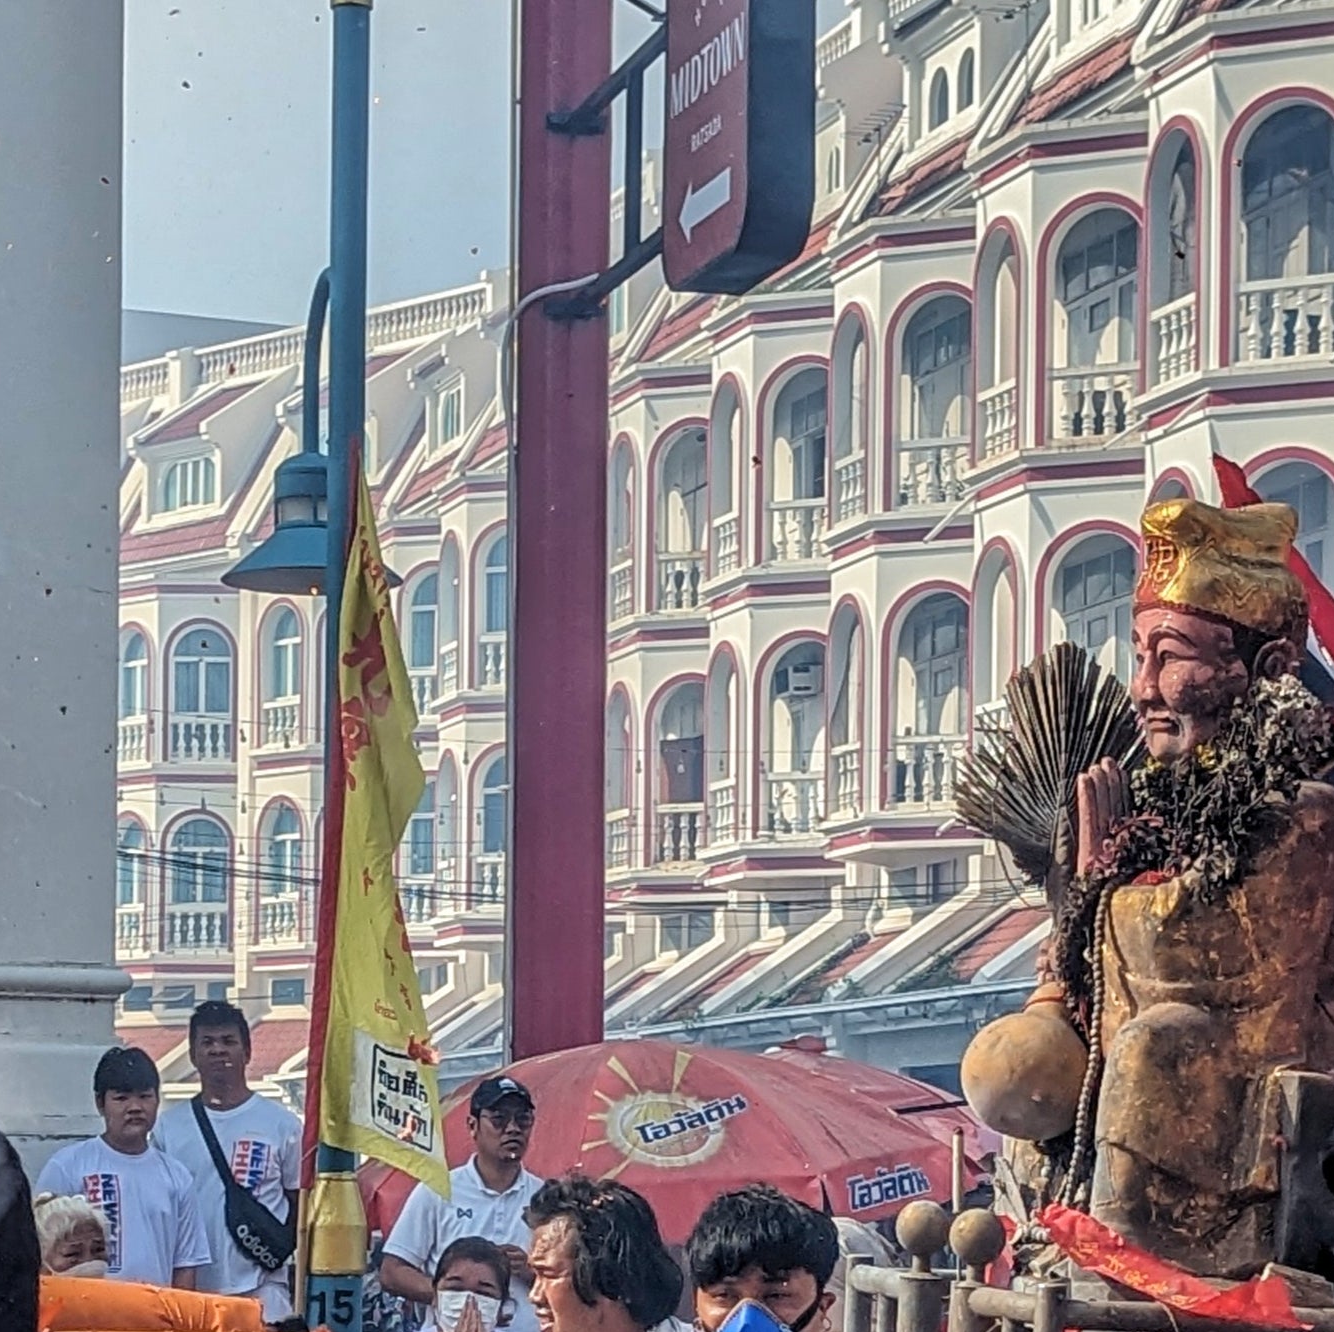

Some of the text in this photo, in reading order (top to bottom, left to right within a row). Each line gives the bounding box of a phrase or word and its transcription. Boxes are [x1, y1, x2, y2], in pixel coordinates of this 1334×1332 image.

[670, 12, 745, 119] MIDTOWN
[634, 1095, 748, 1144] โอวัลติน
[847, 1164, 930, 1210] โอวัลติน
[236, 1224, 280, 1269] adidas
[310, 1290, 354, 1326] 15
